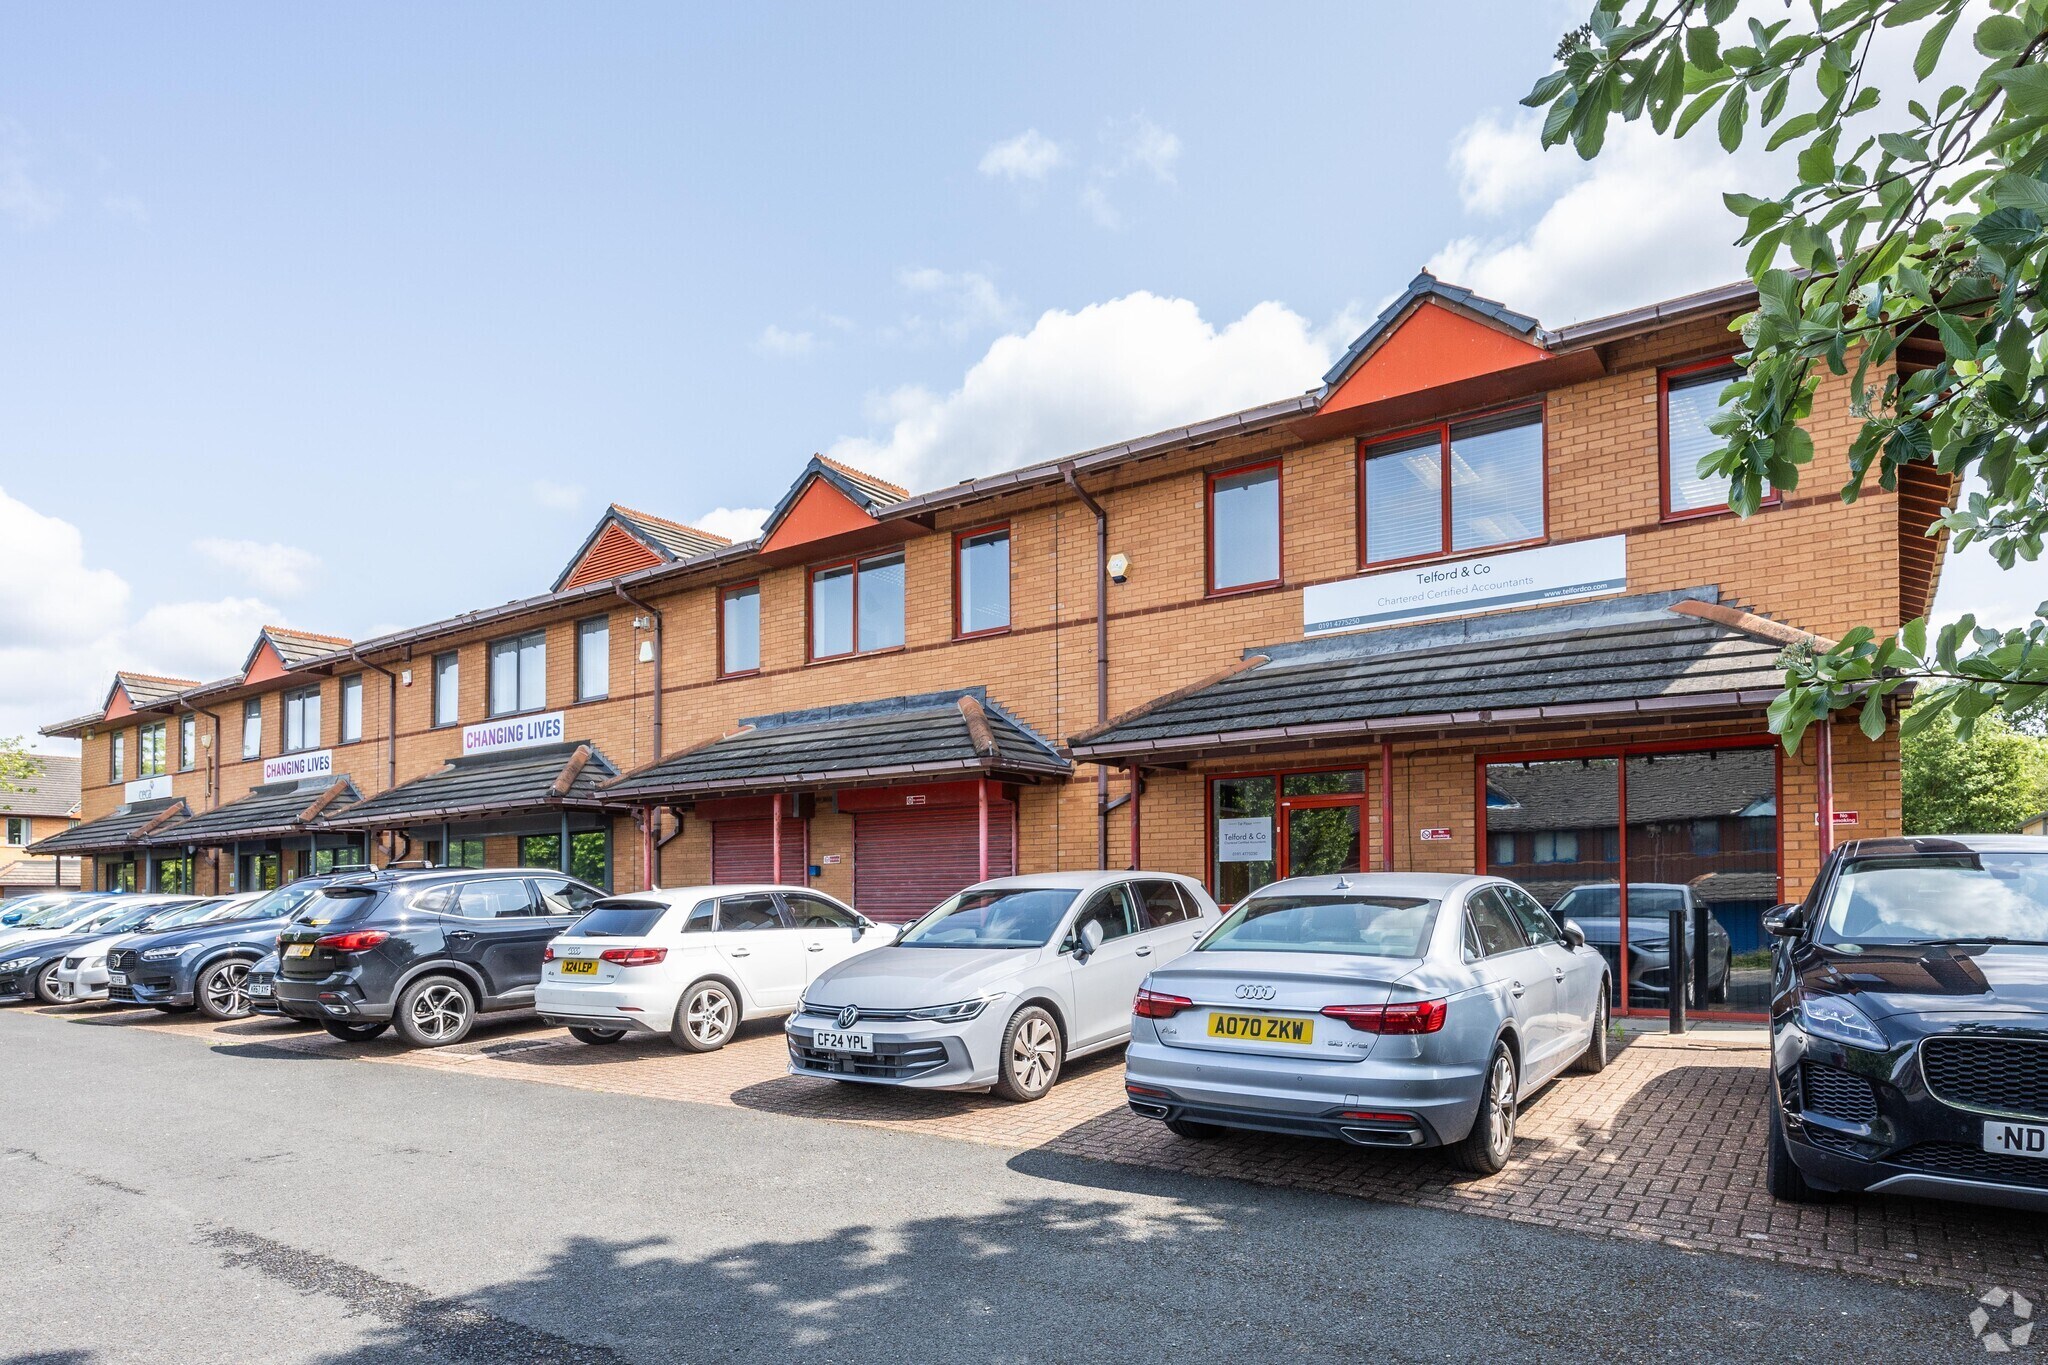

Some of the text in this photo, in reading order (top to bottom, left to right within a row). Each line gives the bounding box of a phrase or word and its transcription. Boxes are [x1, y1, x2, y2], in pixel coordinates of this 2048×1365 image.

[1416, 564, 1491, 585] Telford & Co
[1377, 577, 1534, 607] Chartered Certified Accountants
[1544, 583, 1608, 598] www.telfordco.com
[1318, 617, 1360, 630] 0191 4775250
[466, 719, 561, 749] CHANGING LIVES
[266, 756, 330, 778] CHANGING LIVES
[1255, 832, 1266, 840] Co
[577, 962, 593, 973] LEP
[1214, 1016, 1304, 1040] AO70 ZKW
[817, 1032, 868, 1050] CF24 YPL
[2004, 1126, 2045, 1152] ND
